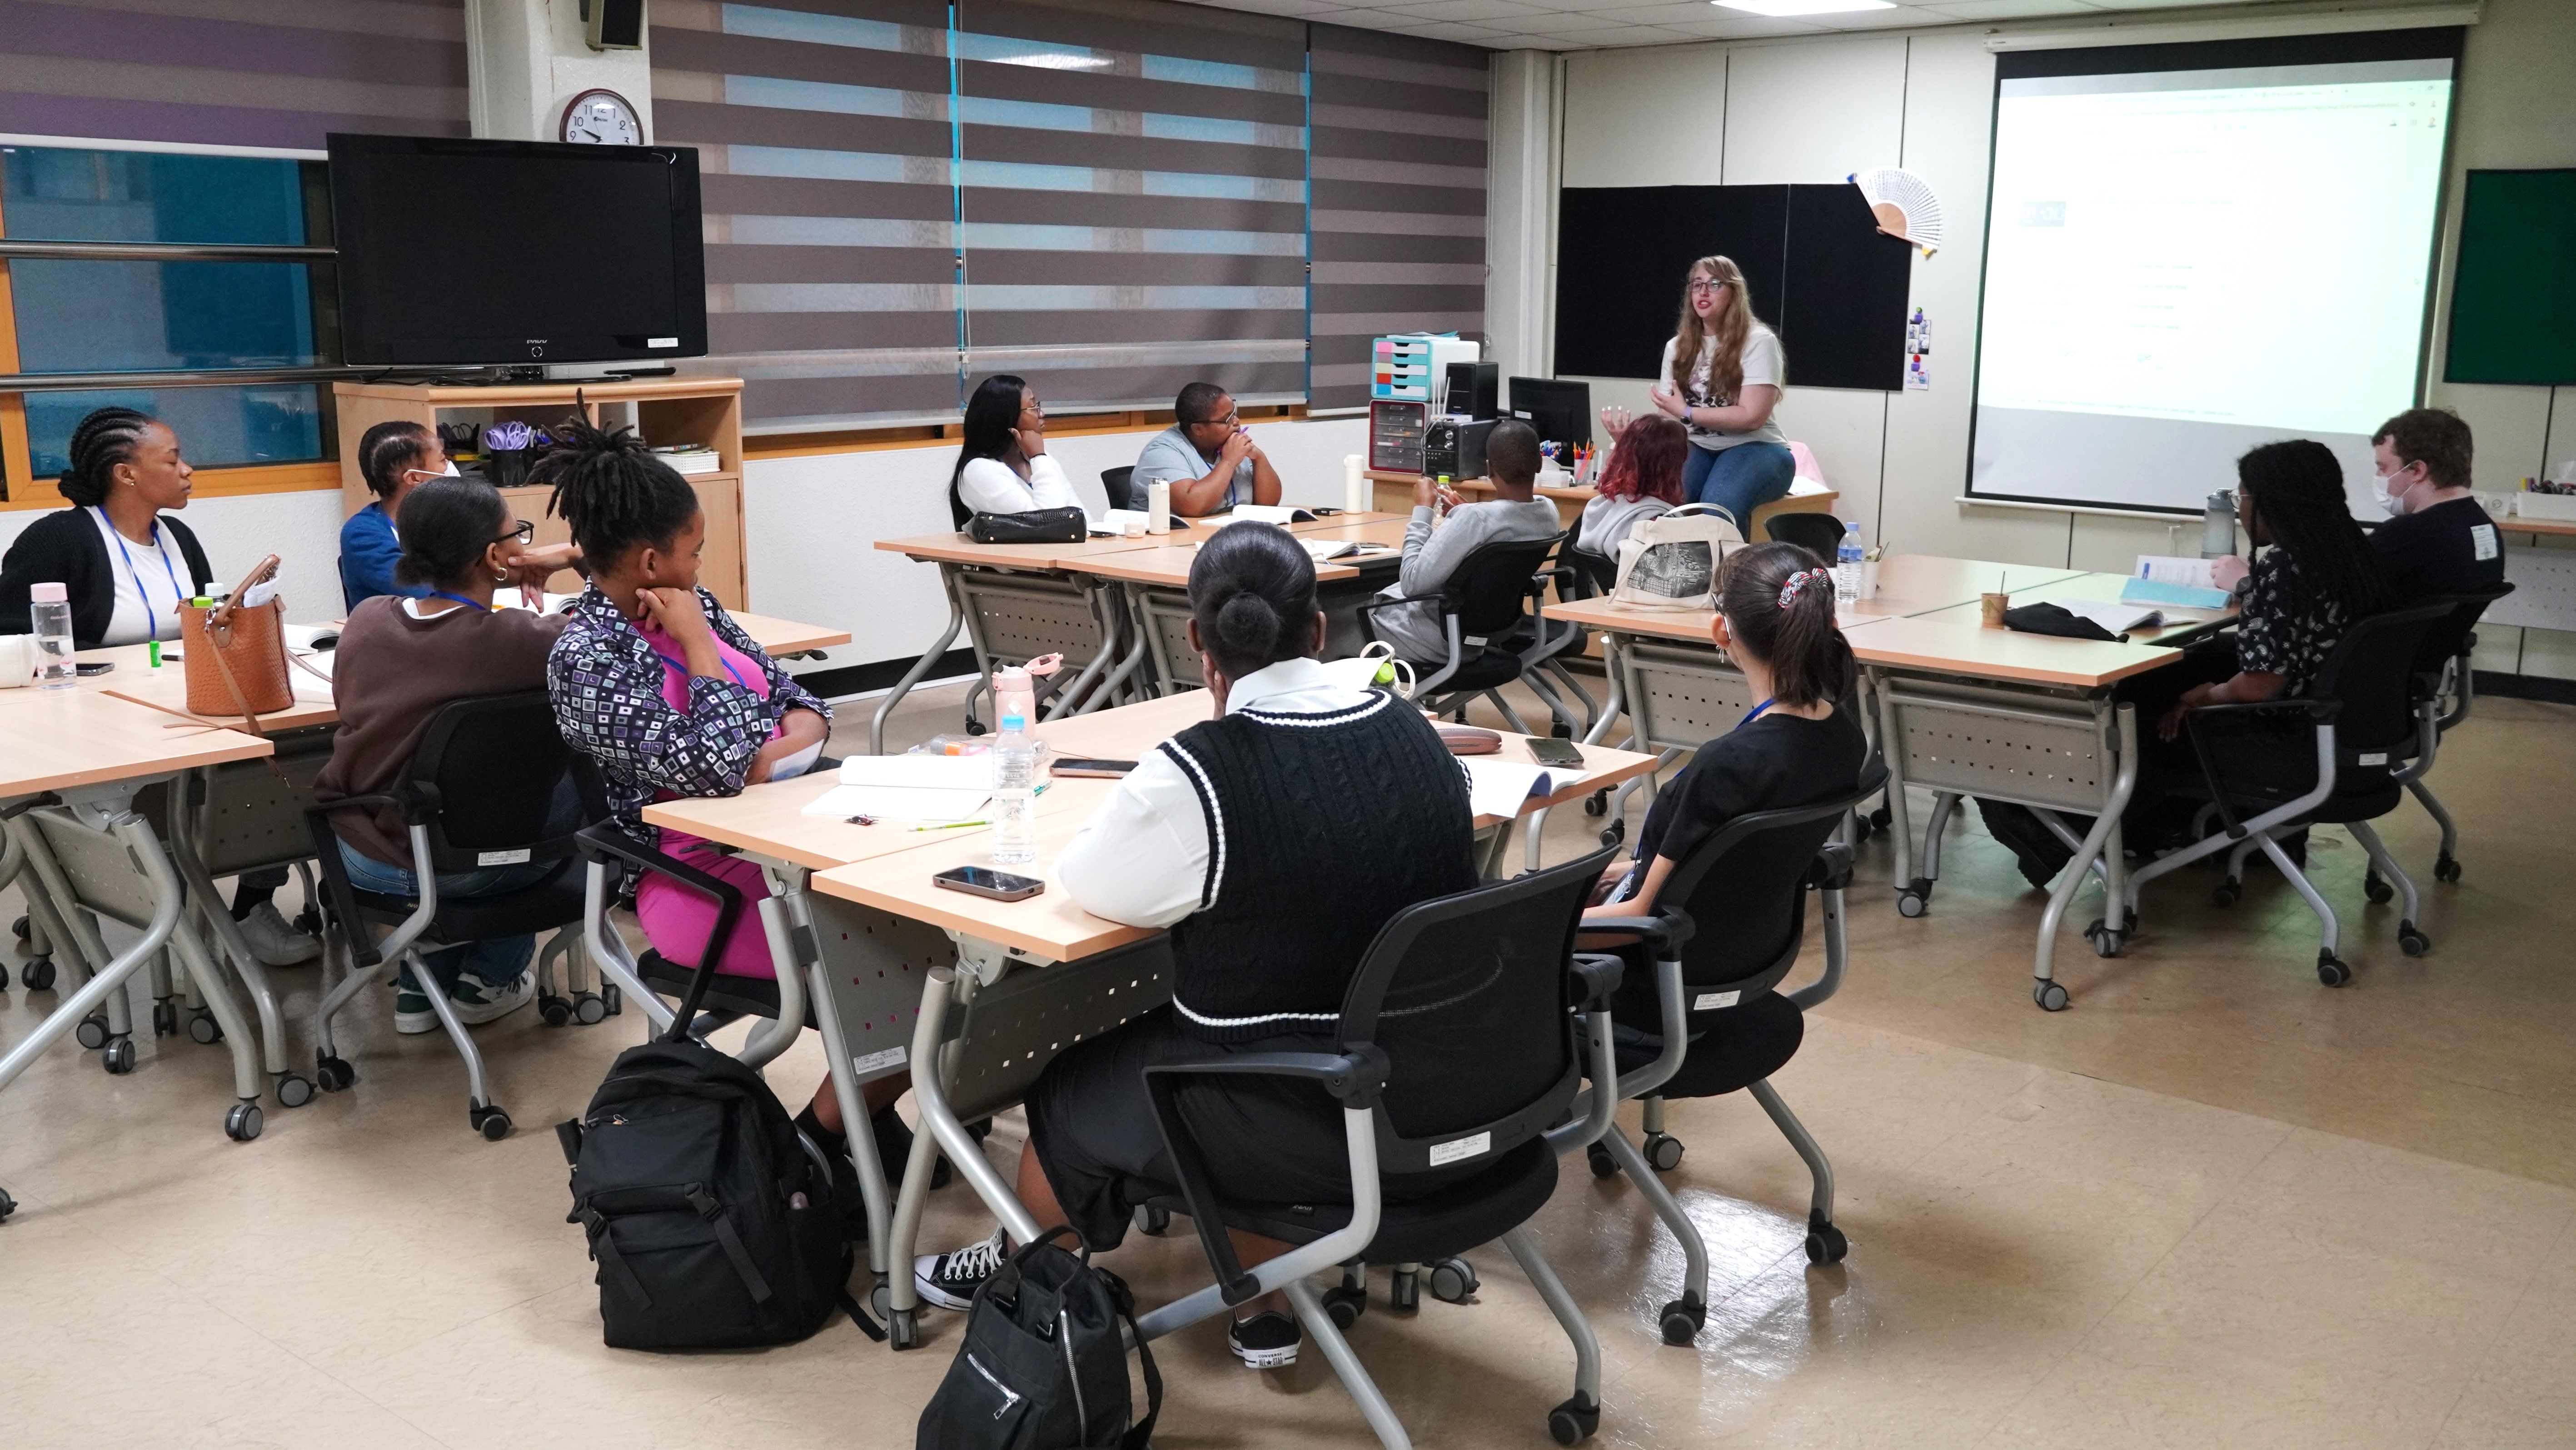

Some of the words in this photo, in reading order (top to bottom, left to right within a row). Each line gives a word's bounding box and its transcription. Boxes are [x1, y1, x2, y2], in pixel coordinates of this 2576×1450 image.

[584, 105, 592, 115] 11
[573, 116, 583, 127] 10
[619, 120, 626, 130] 2
[570, 130, 576, 140] 9
[1273, 1356, 1283, 1365] STAR
